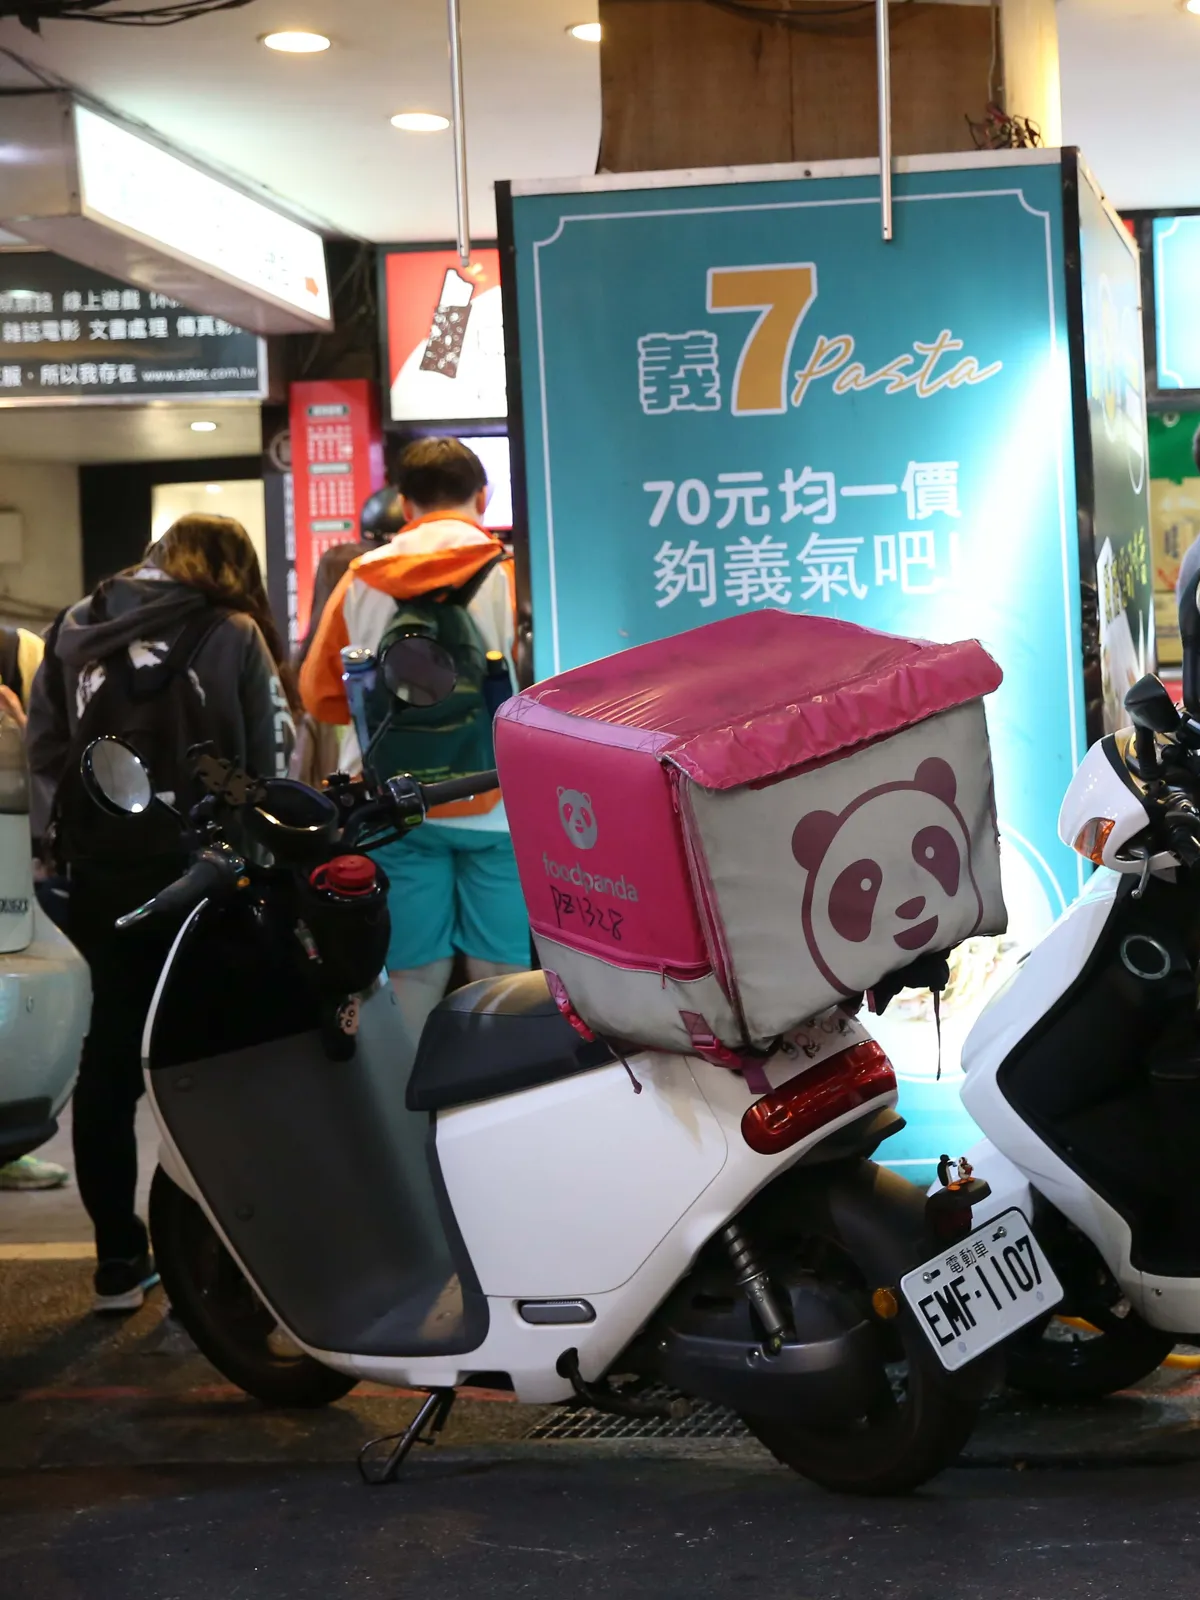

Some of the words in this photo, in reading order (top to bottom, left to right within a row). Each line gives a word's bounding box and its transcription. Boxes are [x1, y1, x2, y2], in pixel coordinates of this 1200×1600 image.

[790, 329, 1003, 406] Pasta
[642, 460, 963, 530] 70元均一價
[542, 851, 639, 902] foodpanda
[945, 1240, 989, 1274] 電動車
